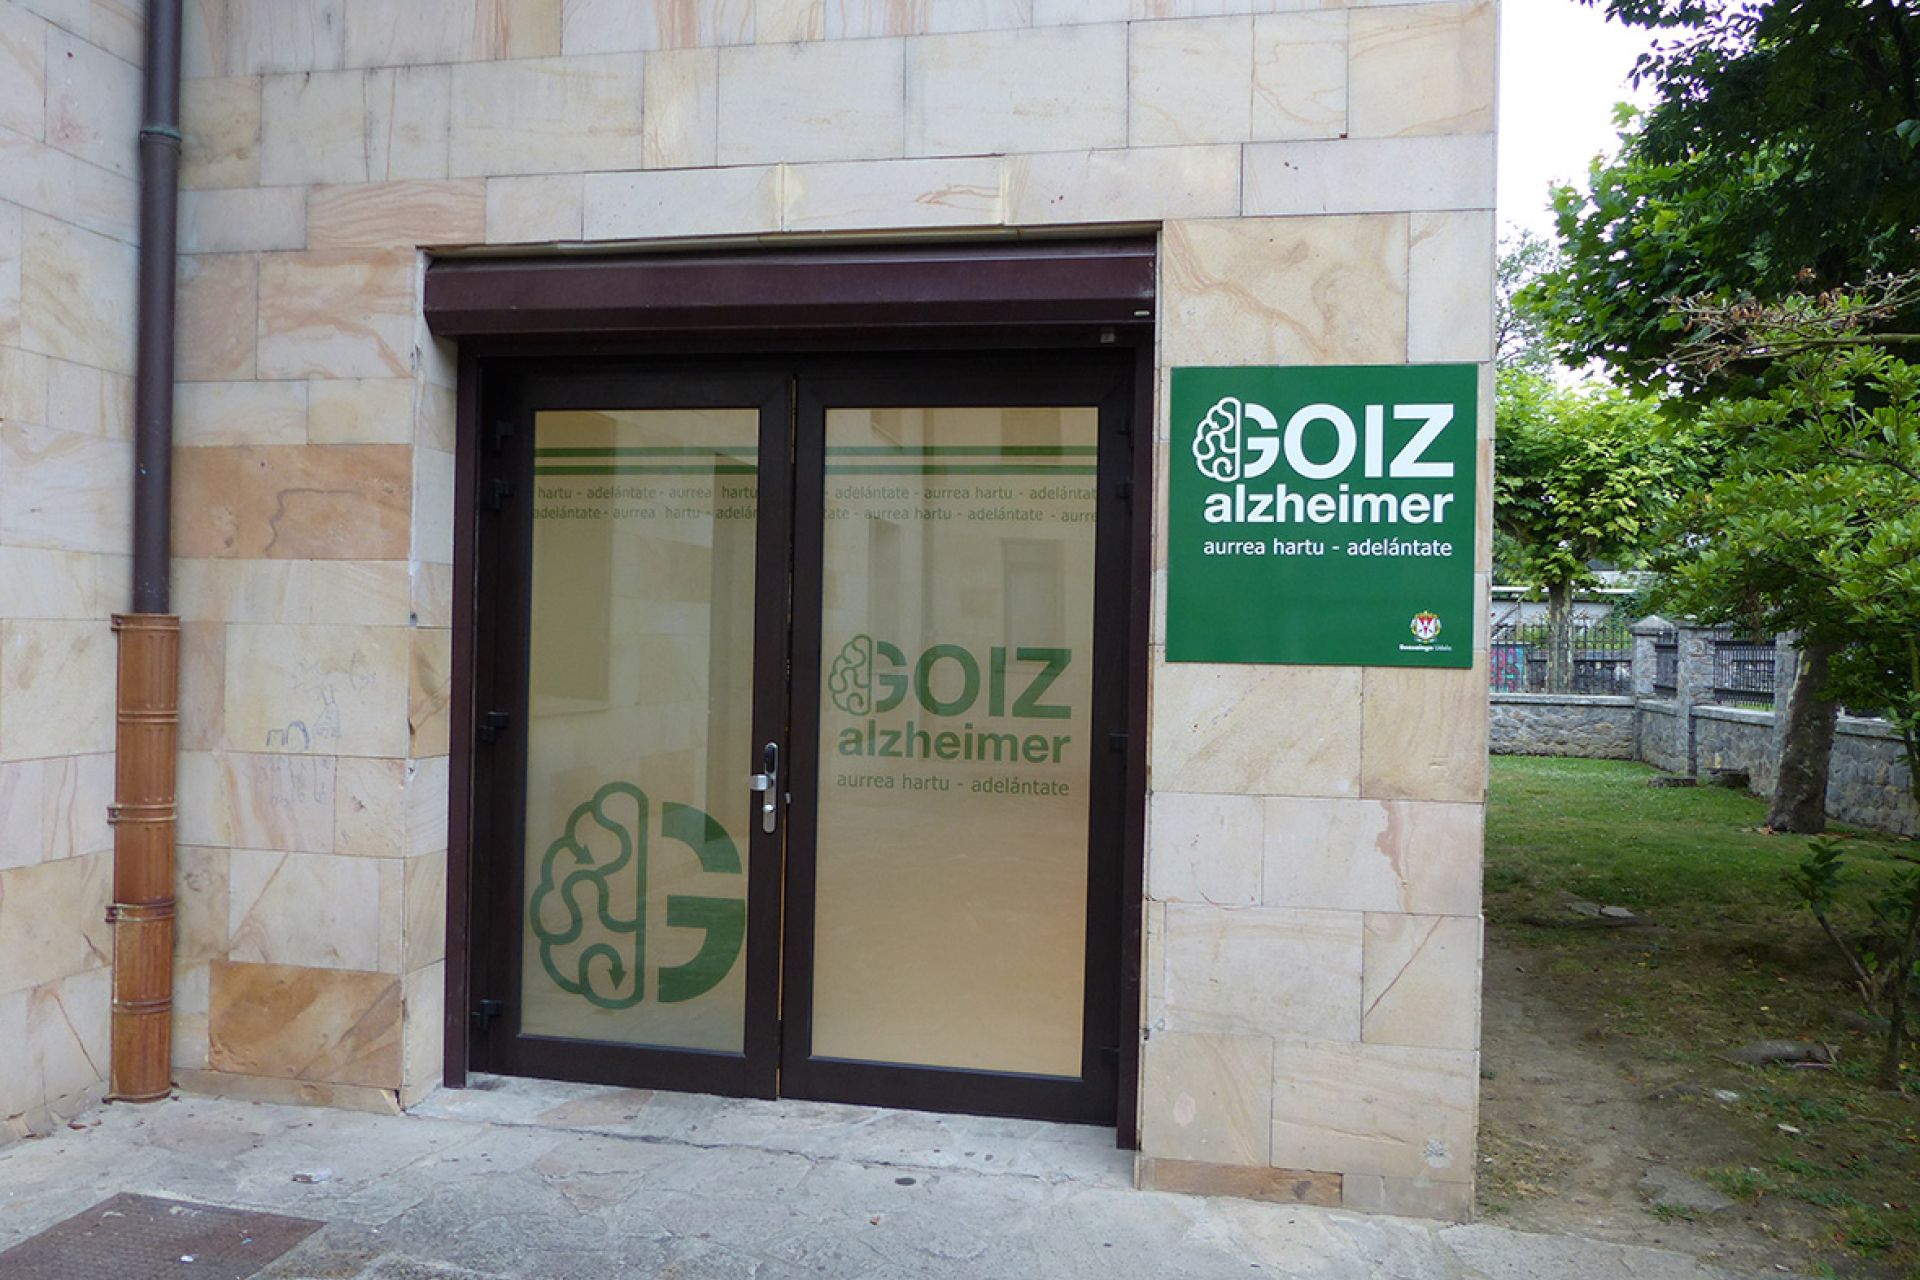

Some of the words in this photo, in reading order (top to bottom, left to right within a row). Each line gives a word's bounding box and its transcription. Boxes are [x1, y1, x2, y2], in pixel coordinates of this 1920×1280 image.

[1244, 403, 1454, 479] GOIZ
[537, 486, 572, 499] hartu
[586, 486, 656, 499] adelántate
[668, 487, 712, 499] aurrea
[835, 485, 910, 499] adelántate
[923, 487, 970, 500] aurrea
[975, 486, 1013, 499] hartu
[612, 507, 656, 519] aurrea
[863, 508, 909, 520] aurrea
[914, 507, 952, 520] hartu
[967, 507, 1043, 521] adelántate
[1203, 483, 1454, 524] alzheimer
[1203, 540, 1265, 555] aurrea
[1273, 538, 1324, 555] hartu
[1347, 537, 1452, 556] adelántate
[876, 641, 1072, 720] GOIZ
[838, 719, 1071, 763] alzheimer
[837, 773, 894, 788] aurrea
[902, 773, 949, 791] hartu
[972, 775, 1070, 796] adelántate
